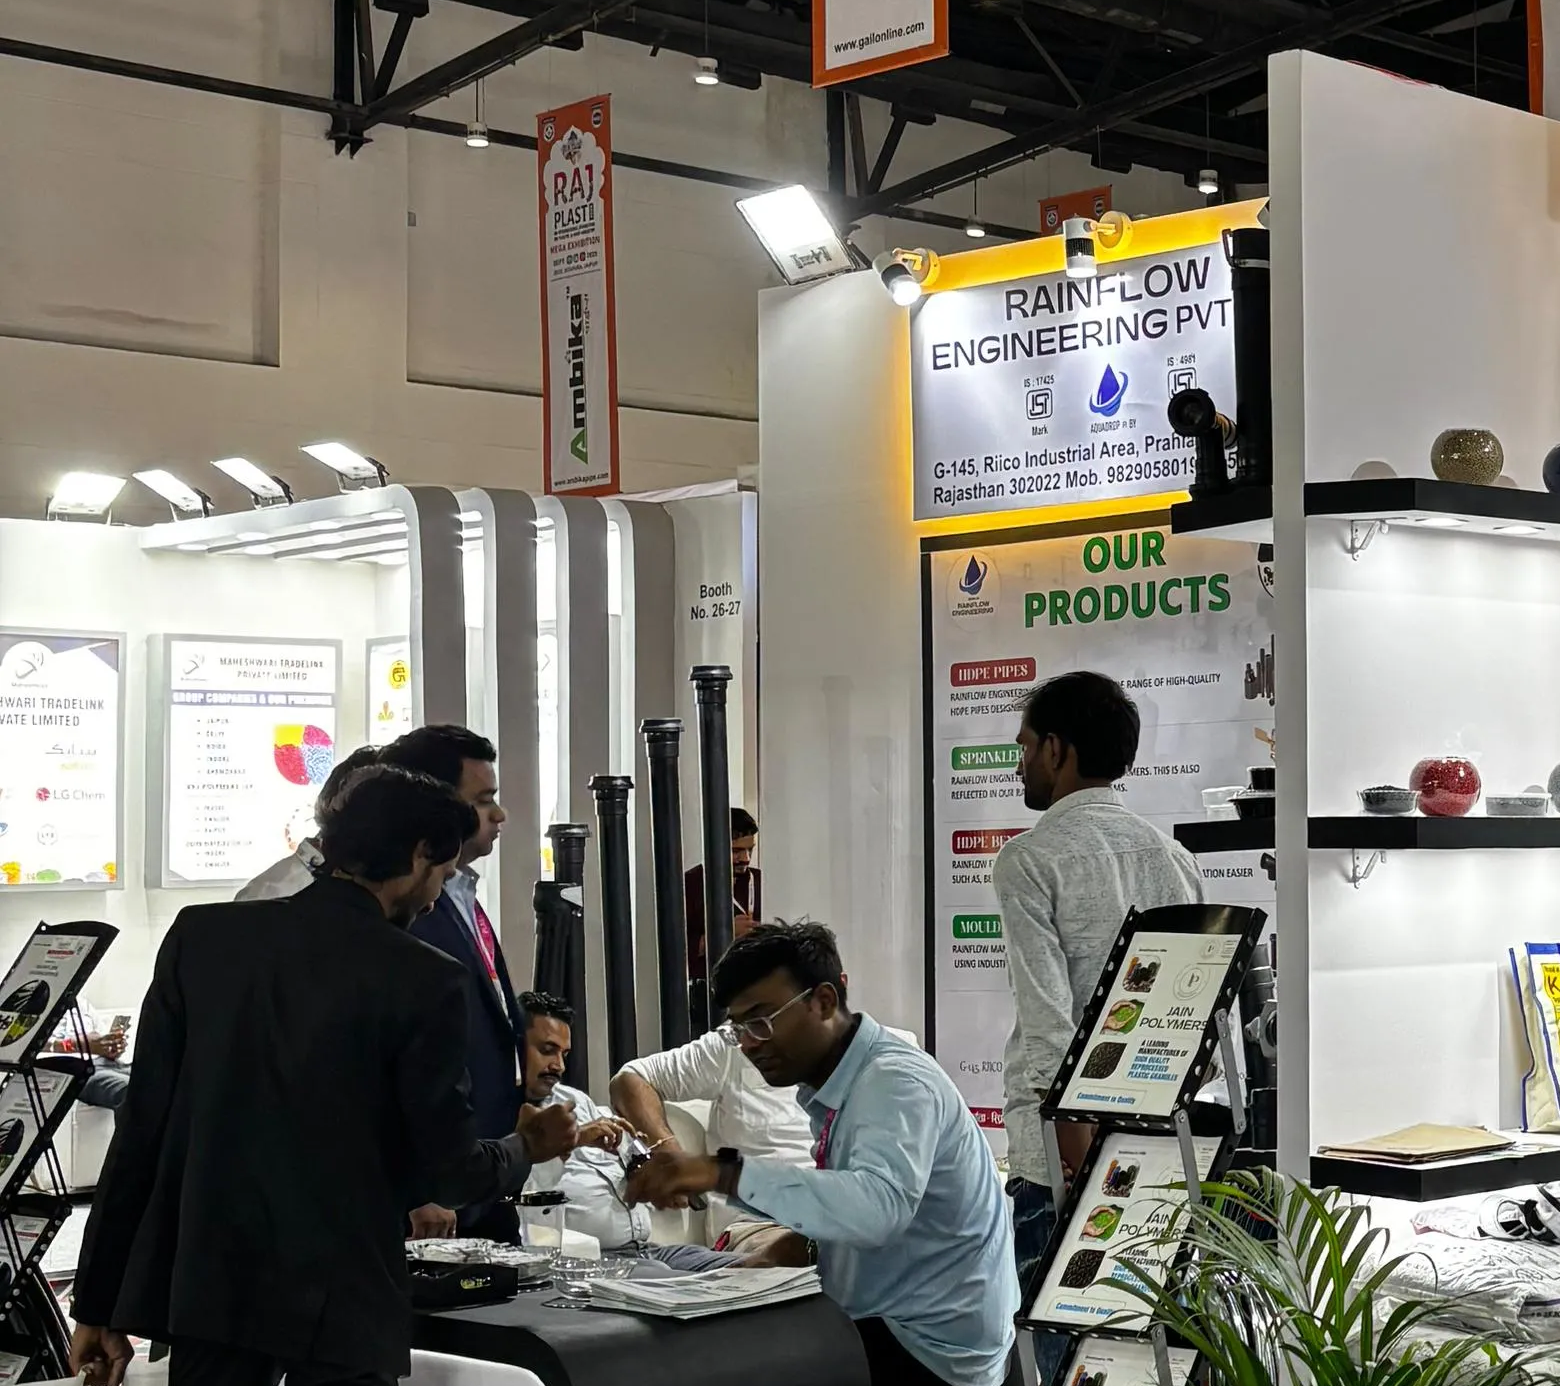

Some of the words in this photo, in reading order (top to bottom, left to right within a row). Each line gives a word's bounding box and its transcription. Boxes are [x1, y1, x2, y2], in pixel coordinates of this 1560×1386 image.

[834, 21, 924, 54] www.gailonline.com
[553, 163, 593, 207] RAJ
[554, 204, 588, 230] PLAST
[1004, 256, 1212, 321] RAINFLOW
[932, 308, 1168, 371] ENGINEERING
[1176, 299, 1232, 334] PVT
[933, 458, 979, 480] G-145,
[983, 452, 1021, 474] Riico
[1025, 443, 1095, 469] Industrial
[1100, 436, 1139, 459] Area,
[933, 483, 1005, 506] Rajasthan
[1009, 476, 1061, 495] 302022
[1065, 471, 1102, 489] Mob.
[1082, 530, 1167, 574] OUR
[699, 581, 733, 600] Booth
[1023, 573, 1231, 628] PRODUCTS
[690, 604, 710, 621] No.
[712, 600, 741, 618] 26-27
[994, 664, 1028, 678] PIPES
[40, 697, 105, 710] TRADELINK
[32, 715, 80, 726] LIMITED
[53, 789, 70, 800] LG
[73, 790, 105, 800] Chem
